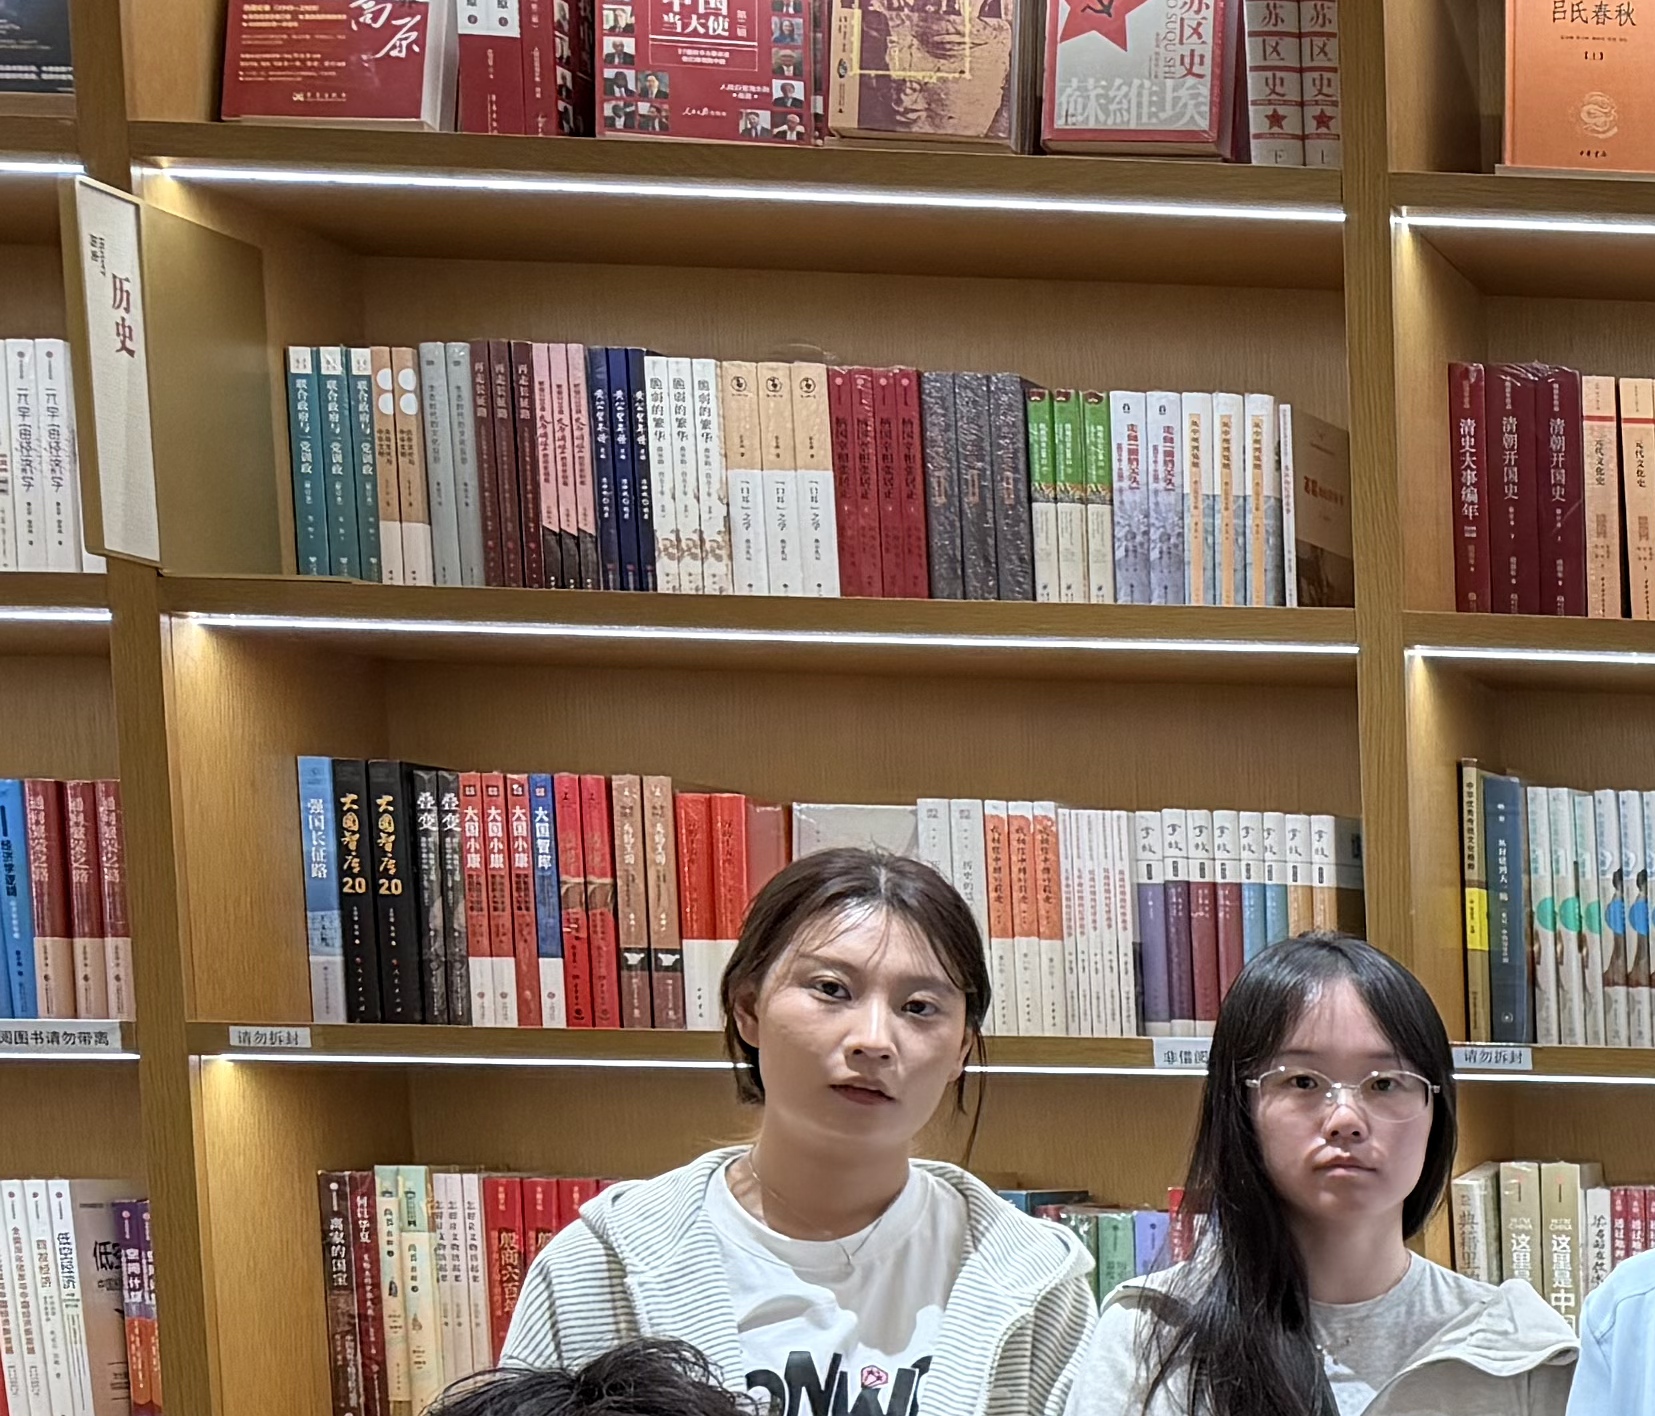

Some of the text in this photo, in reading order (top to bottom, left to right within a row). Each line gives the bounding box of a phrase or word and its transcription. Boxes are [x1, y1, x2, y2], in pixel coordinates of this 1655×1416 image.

[661, 13, 729, 37] 当大使
[1551, 0, 1637, 27] 吕氏春秋
[1261, 2, 1285, 97] 苏区史
[1310, 3, 1335, 98] 苏区史
[111, 272, 135, 358] 历史
[1460, 418, 1478, 521] 清史大事编年
[1502, 416, 1519, 501] 清朝开国史
[1549, 418, 1567, 503] 清朝开国史
[307, 799, 328, 879] 强国长征路
[464, 805, 480, 870] 大国小康
[487, 805, 504, 869] 大国小康
[512, 805, 528, 869] 大国小康
[535, 806, 553, 870] 大国智库
[342, 877, 367, 894] 20
[378, 879, 403, 896] 20
[0, 1030, 109, 1046] 阅图书请勿带离
[238, 1030, 299, 1046] 请勿拆封
[1464, 1049, 1523, 1064] 请勿拆封
[1551, 1235, 1577, 1332] 这里是中国
